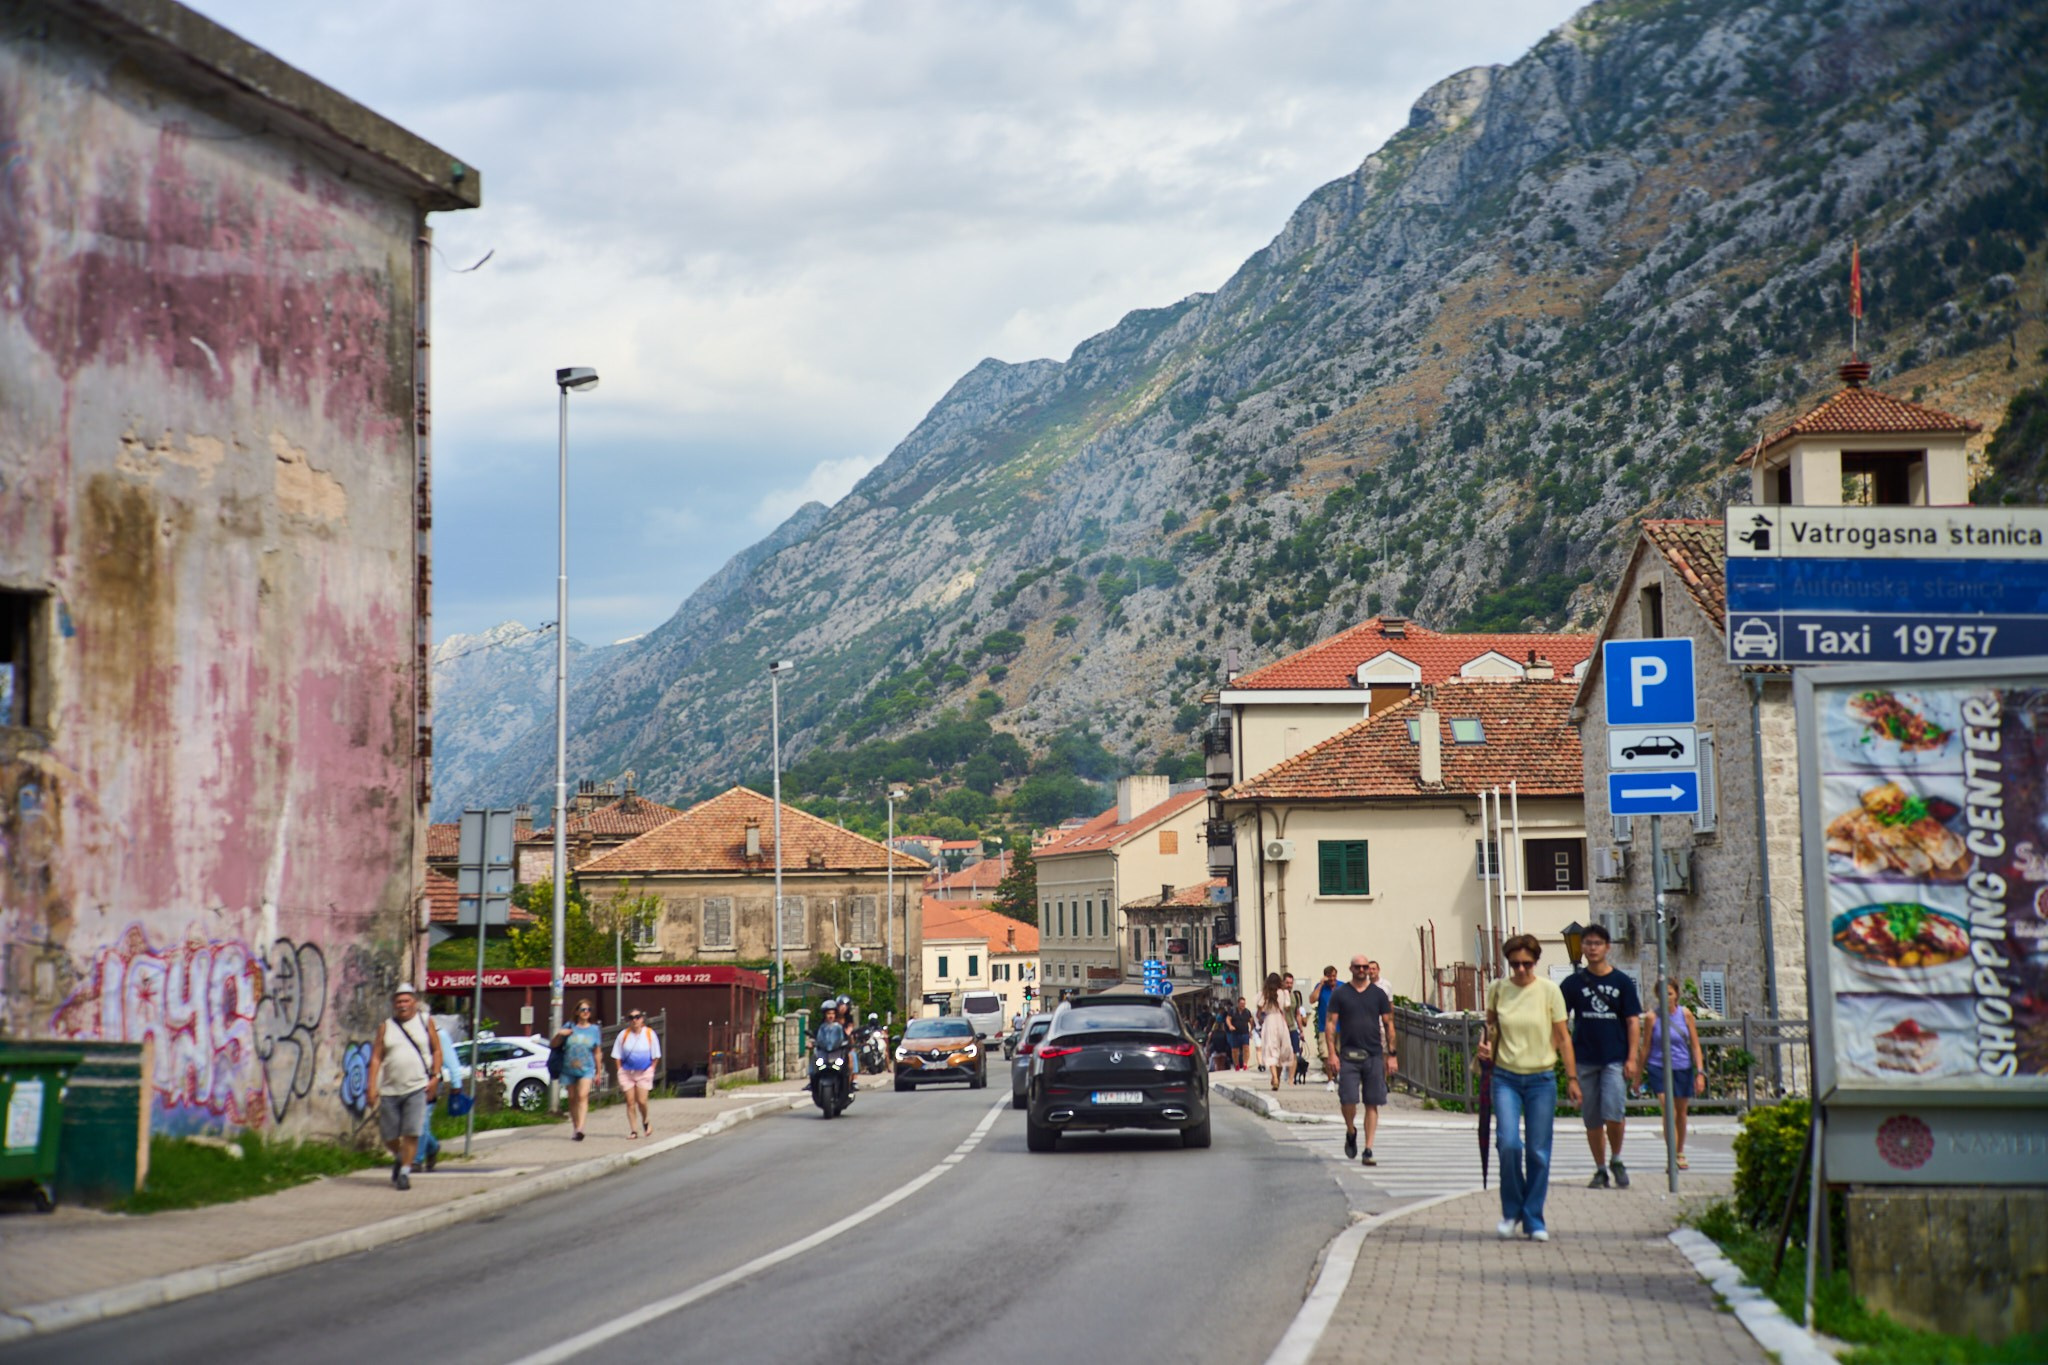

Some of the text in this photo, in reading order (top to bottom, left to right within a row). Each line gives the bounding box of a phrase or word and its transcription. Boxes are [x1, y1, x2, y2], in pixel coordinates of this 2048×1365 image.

[1791, 521, 2043, 549] Vatrogasna stanica
[1792, 576, 2006, 599] Autobuska stanica
[1798, 624, 1998, 656] Taxi 19757
[1630, 656, 1668, 707] P
[1961, 699, 2018, 1078] SHOPPING CENTER
[654, 972, 711, 983] 069 324 722
